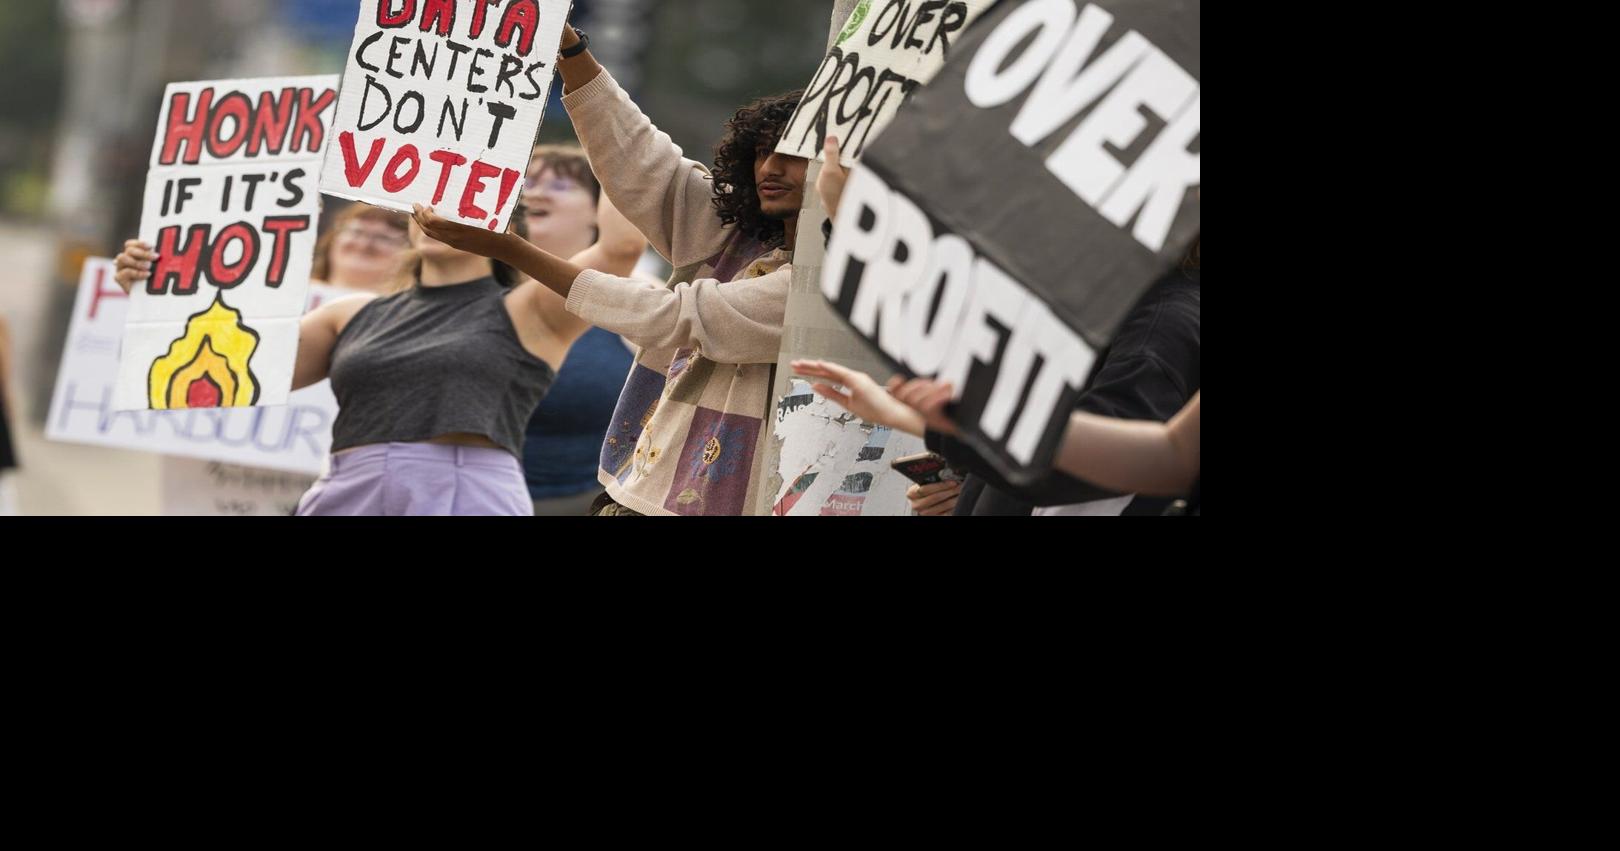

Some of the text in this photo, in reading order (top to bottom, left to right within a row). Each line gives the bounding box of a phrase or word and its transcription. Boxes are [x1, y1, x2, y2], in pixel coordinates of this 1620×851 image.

[356, 31, 546, 100] CENTERS
[867, 0, 967, 54] OVER
[159, 87, 336, 165] HONK
[357, 74, 517, 149] DON'T
[964, 0, 1200, 252] OVER
[161, 168, 307, 217] IF IT'S
[339, 131, 521, 231] VOTE!
[146, 215, 311, 296] HOT
[820, 164, 1097, 466] PROFIT
